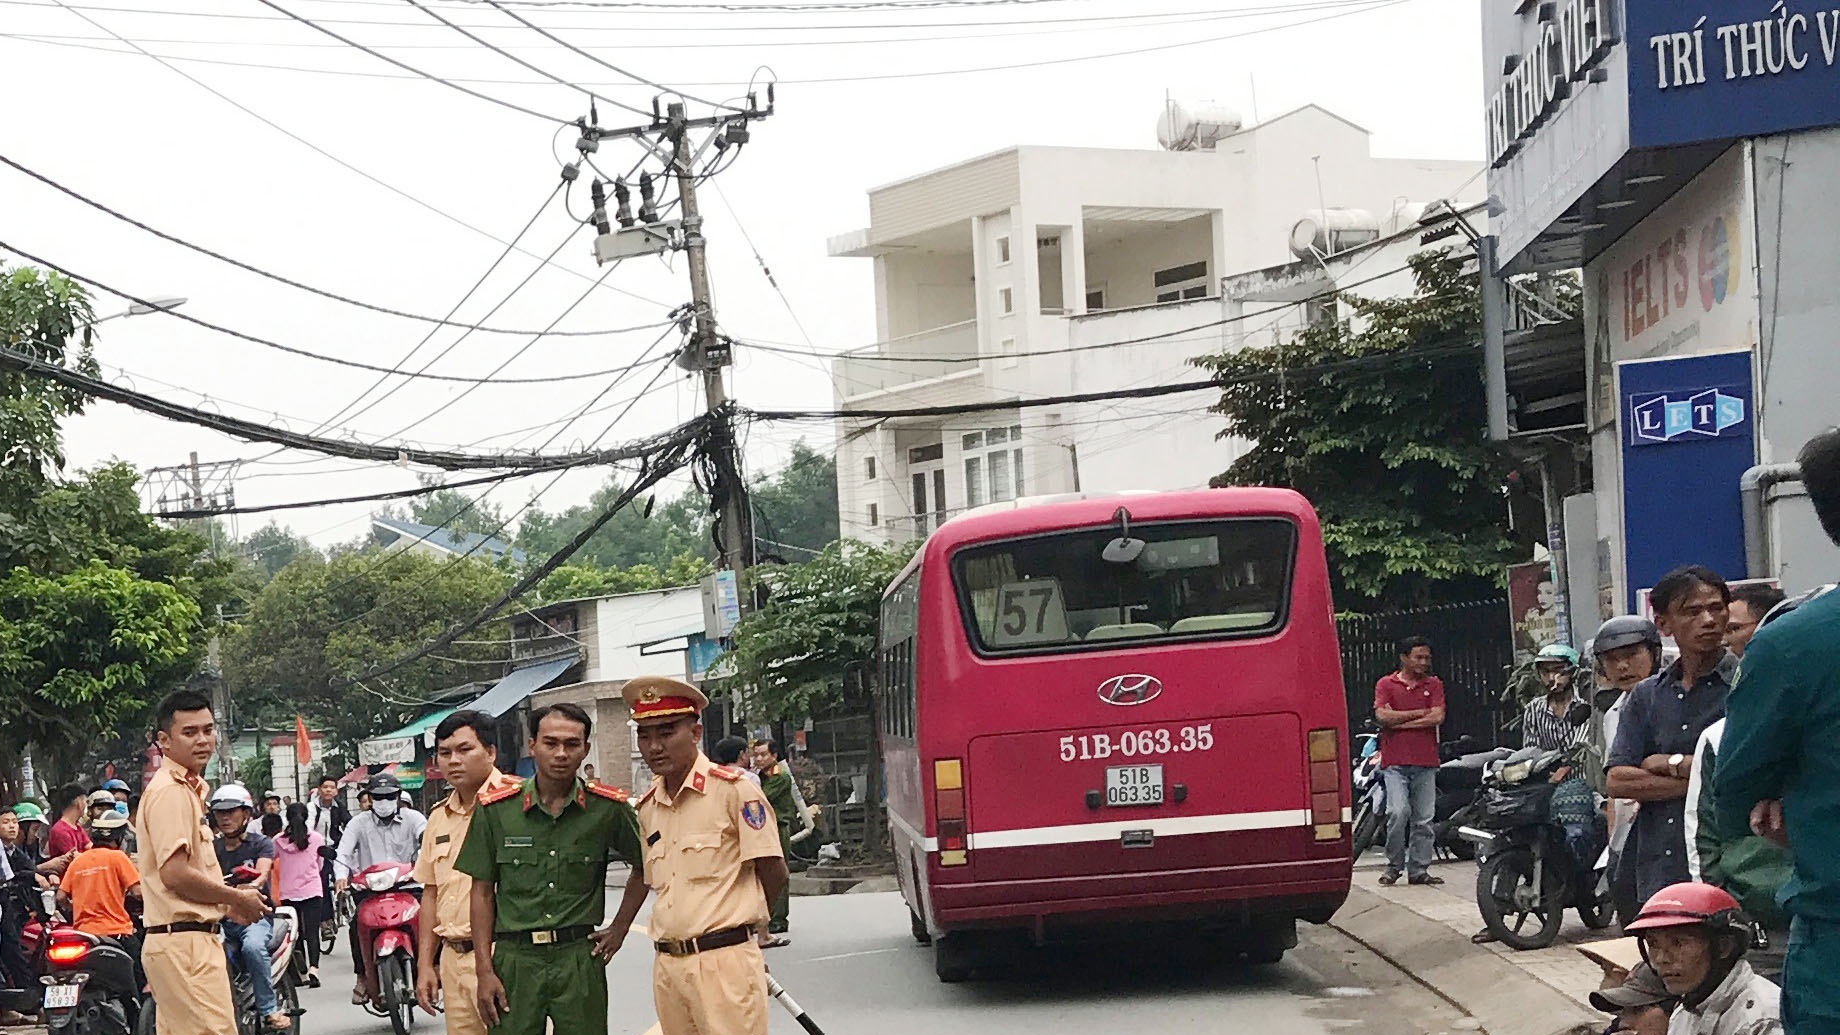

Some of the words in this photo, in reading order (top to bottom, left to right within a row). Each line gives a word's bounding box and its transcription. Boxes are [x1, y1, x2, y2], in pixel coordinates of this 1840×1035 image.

[1650, 15, 1707, 89] TRÍ
[1716, 0, 1809, 80] THỨC
[1623, 227, 1690, 342] IELTS
[1641, 402, 1738, 431] LETS
[1003, 588, 1054, 637] 57
[1059, 723, 1214, 762] 51B-063.35
[1108, 784, 1162, 803] 063.35
[1119, 767, 1150, 785] 51B
